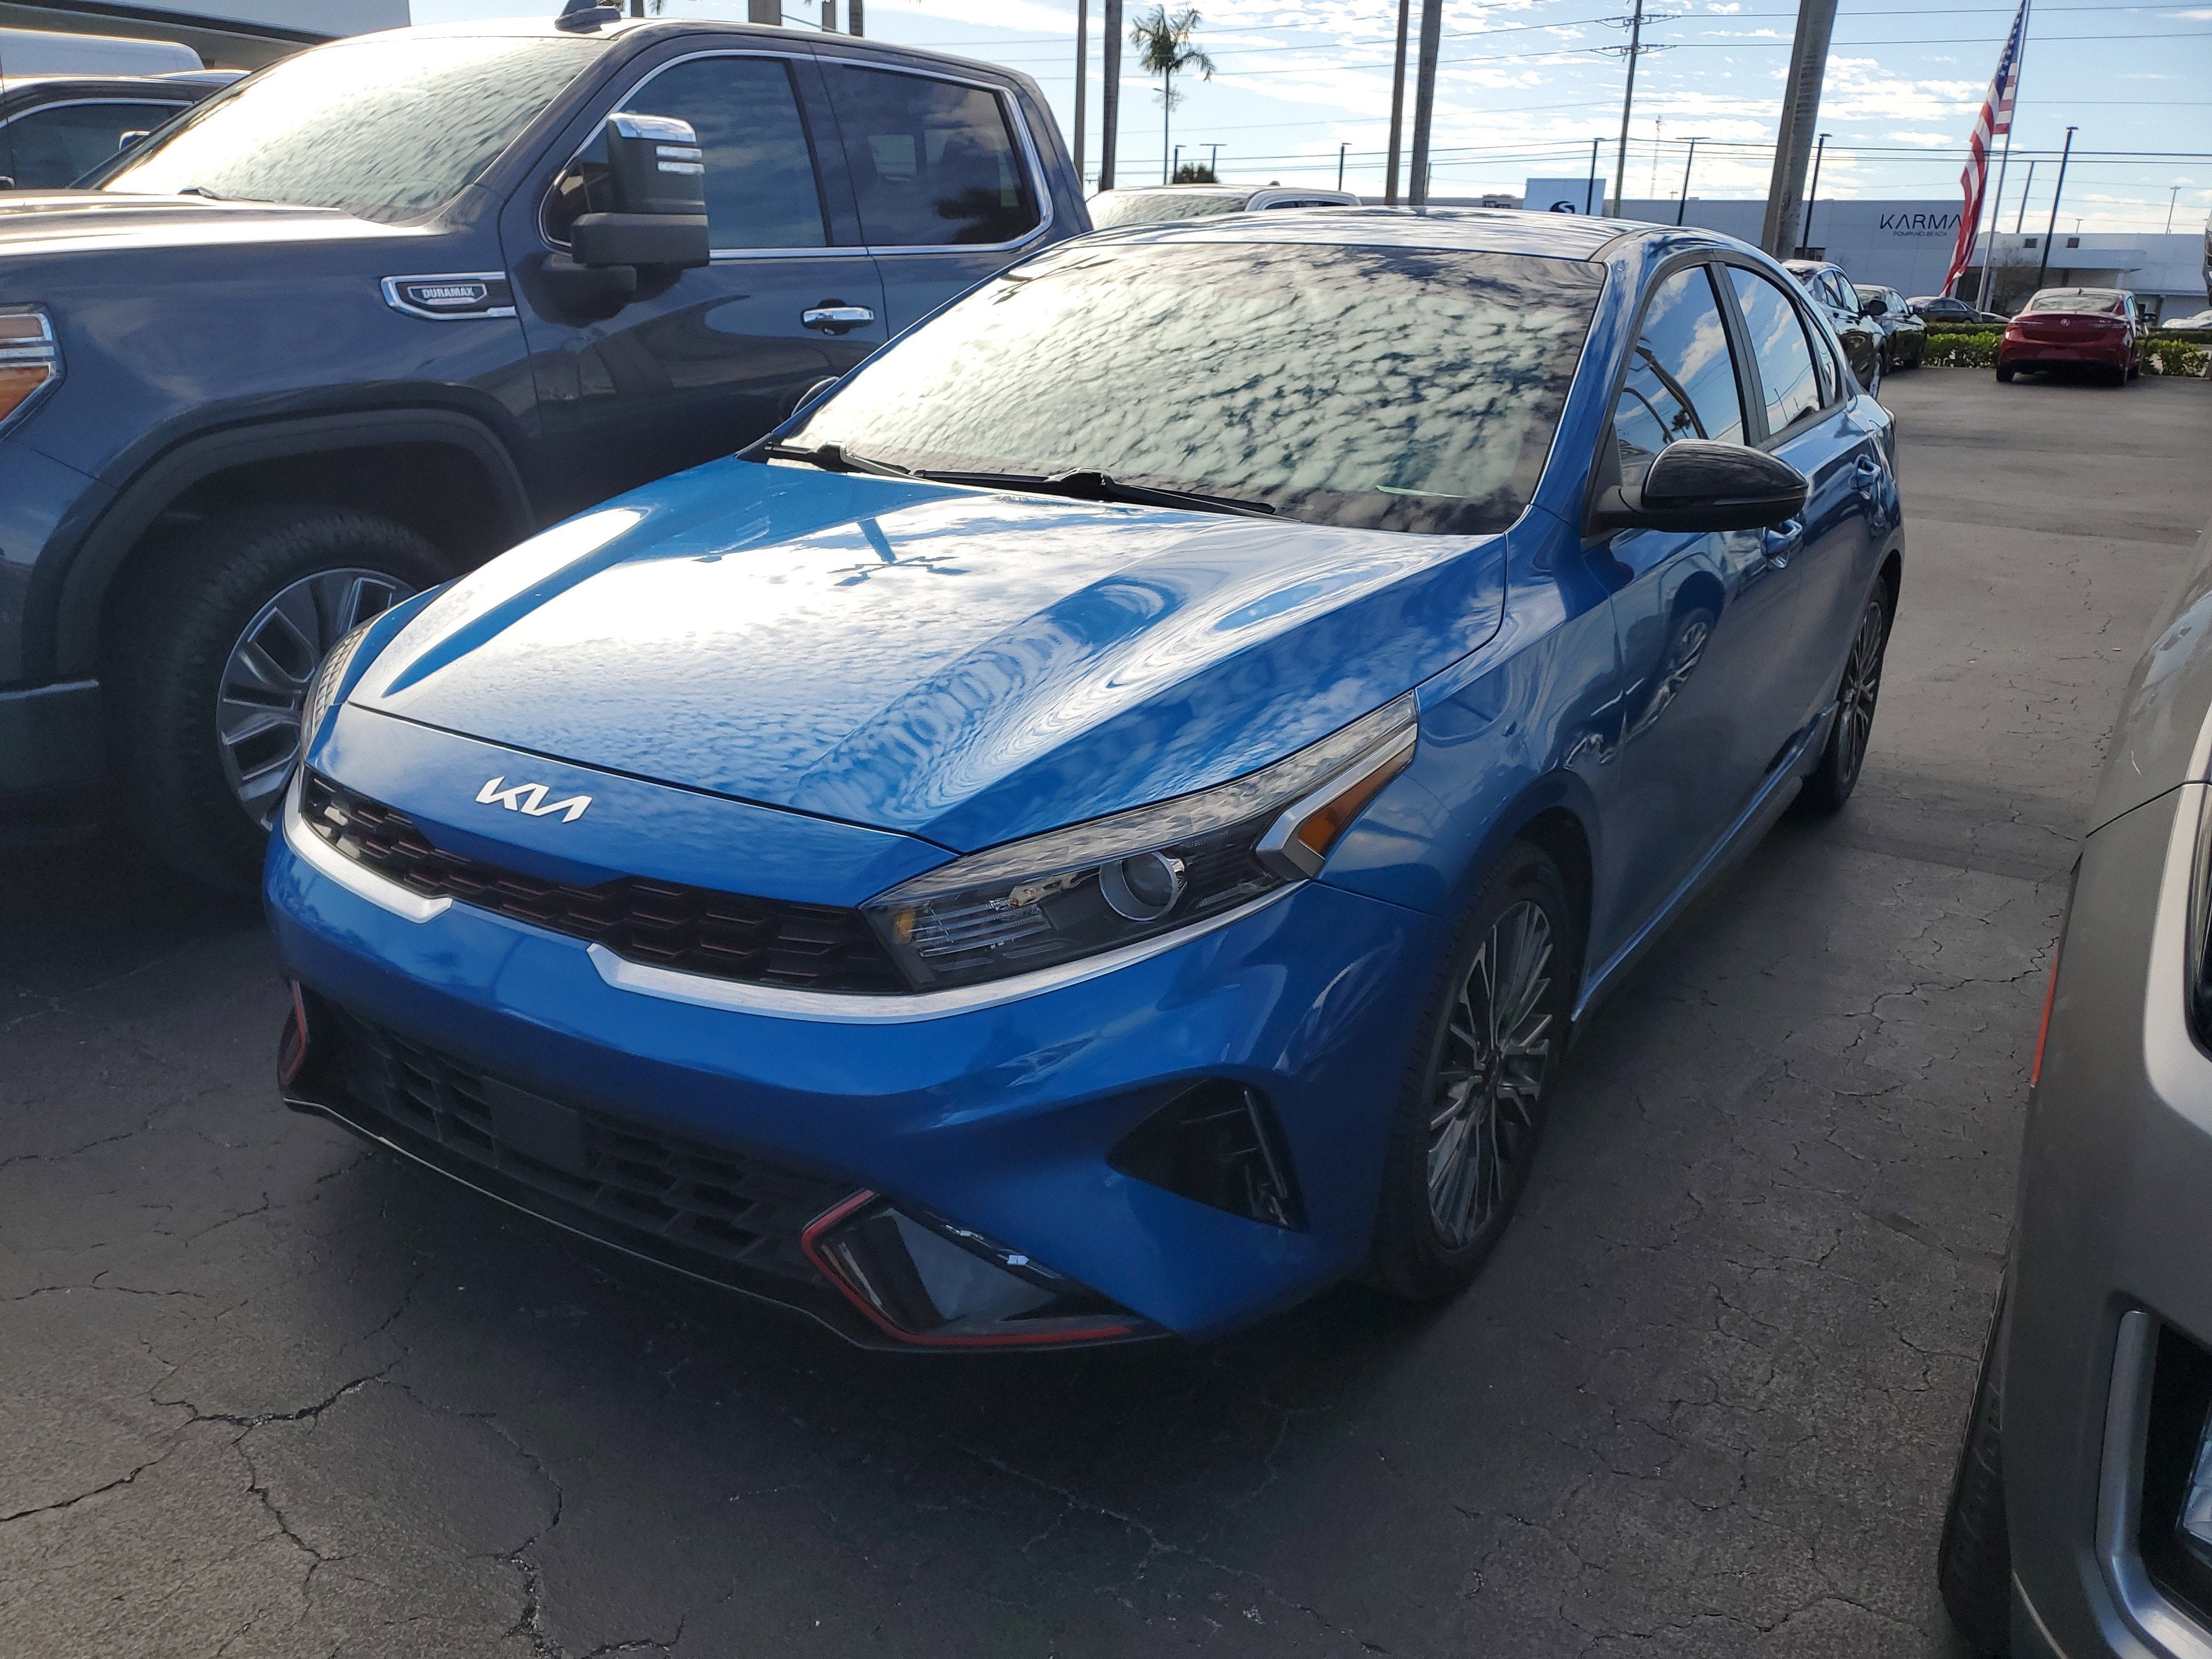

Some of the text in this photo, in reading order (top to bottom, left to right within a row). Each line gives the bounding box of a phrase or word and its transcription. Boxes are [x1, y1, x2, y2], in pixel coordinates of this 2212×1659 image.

[1880, 214, 1961, 229] KARMA
[421, 286, 475, 298] DURAMAX
[475, 775, 592, 823] KIA
